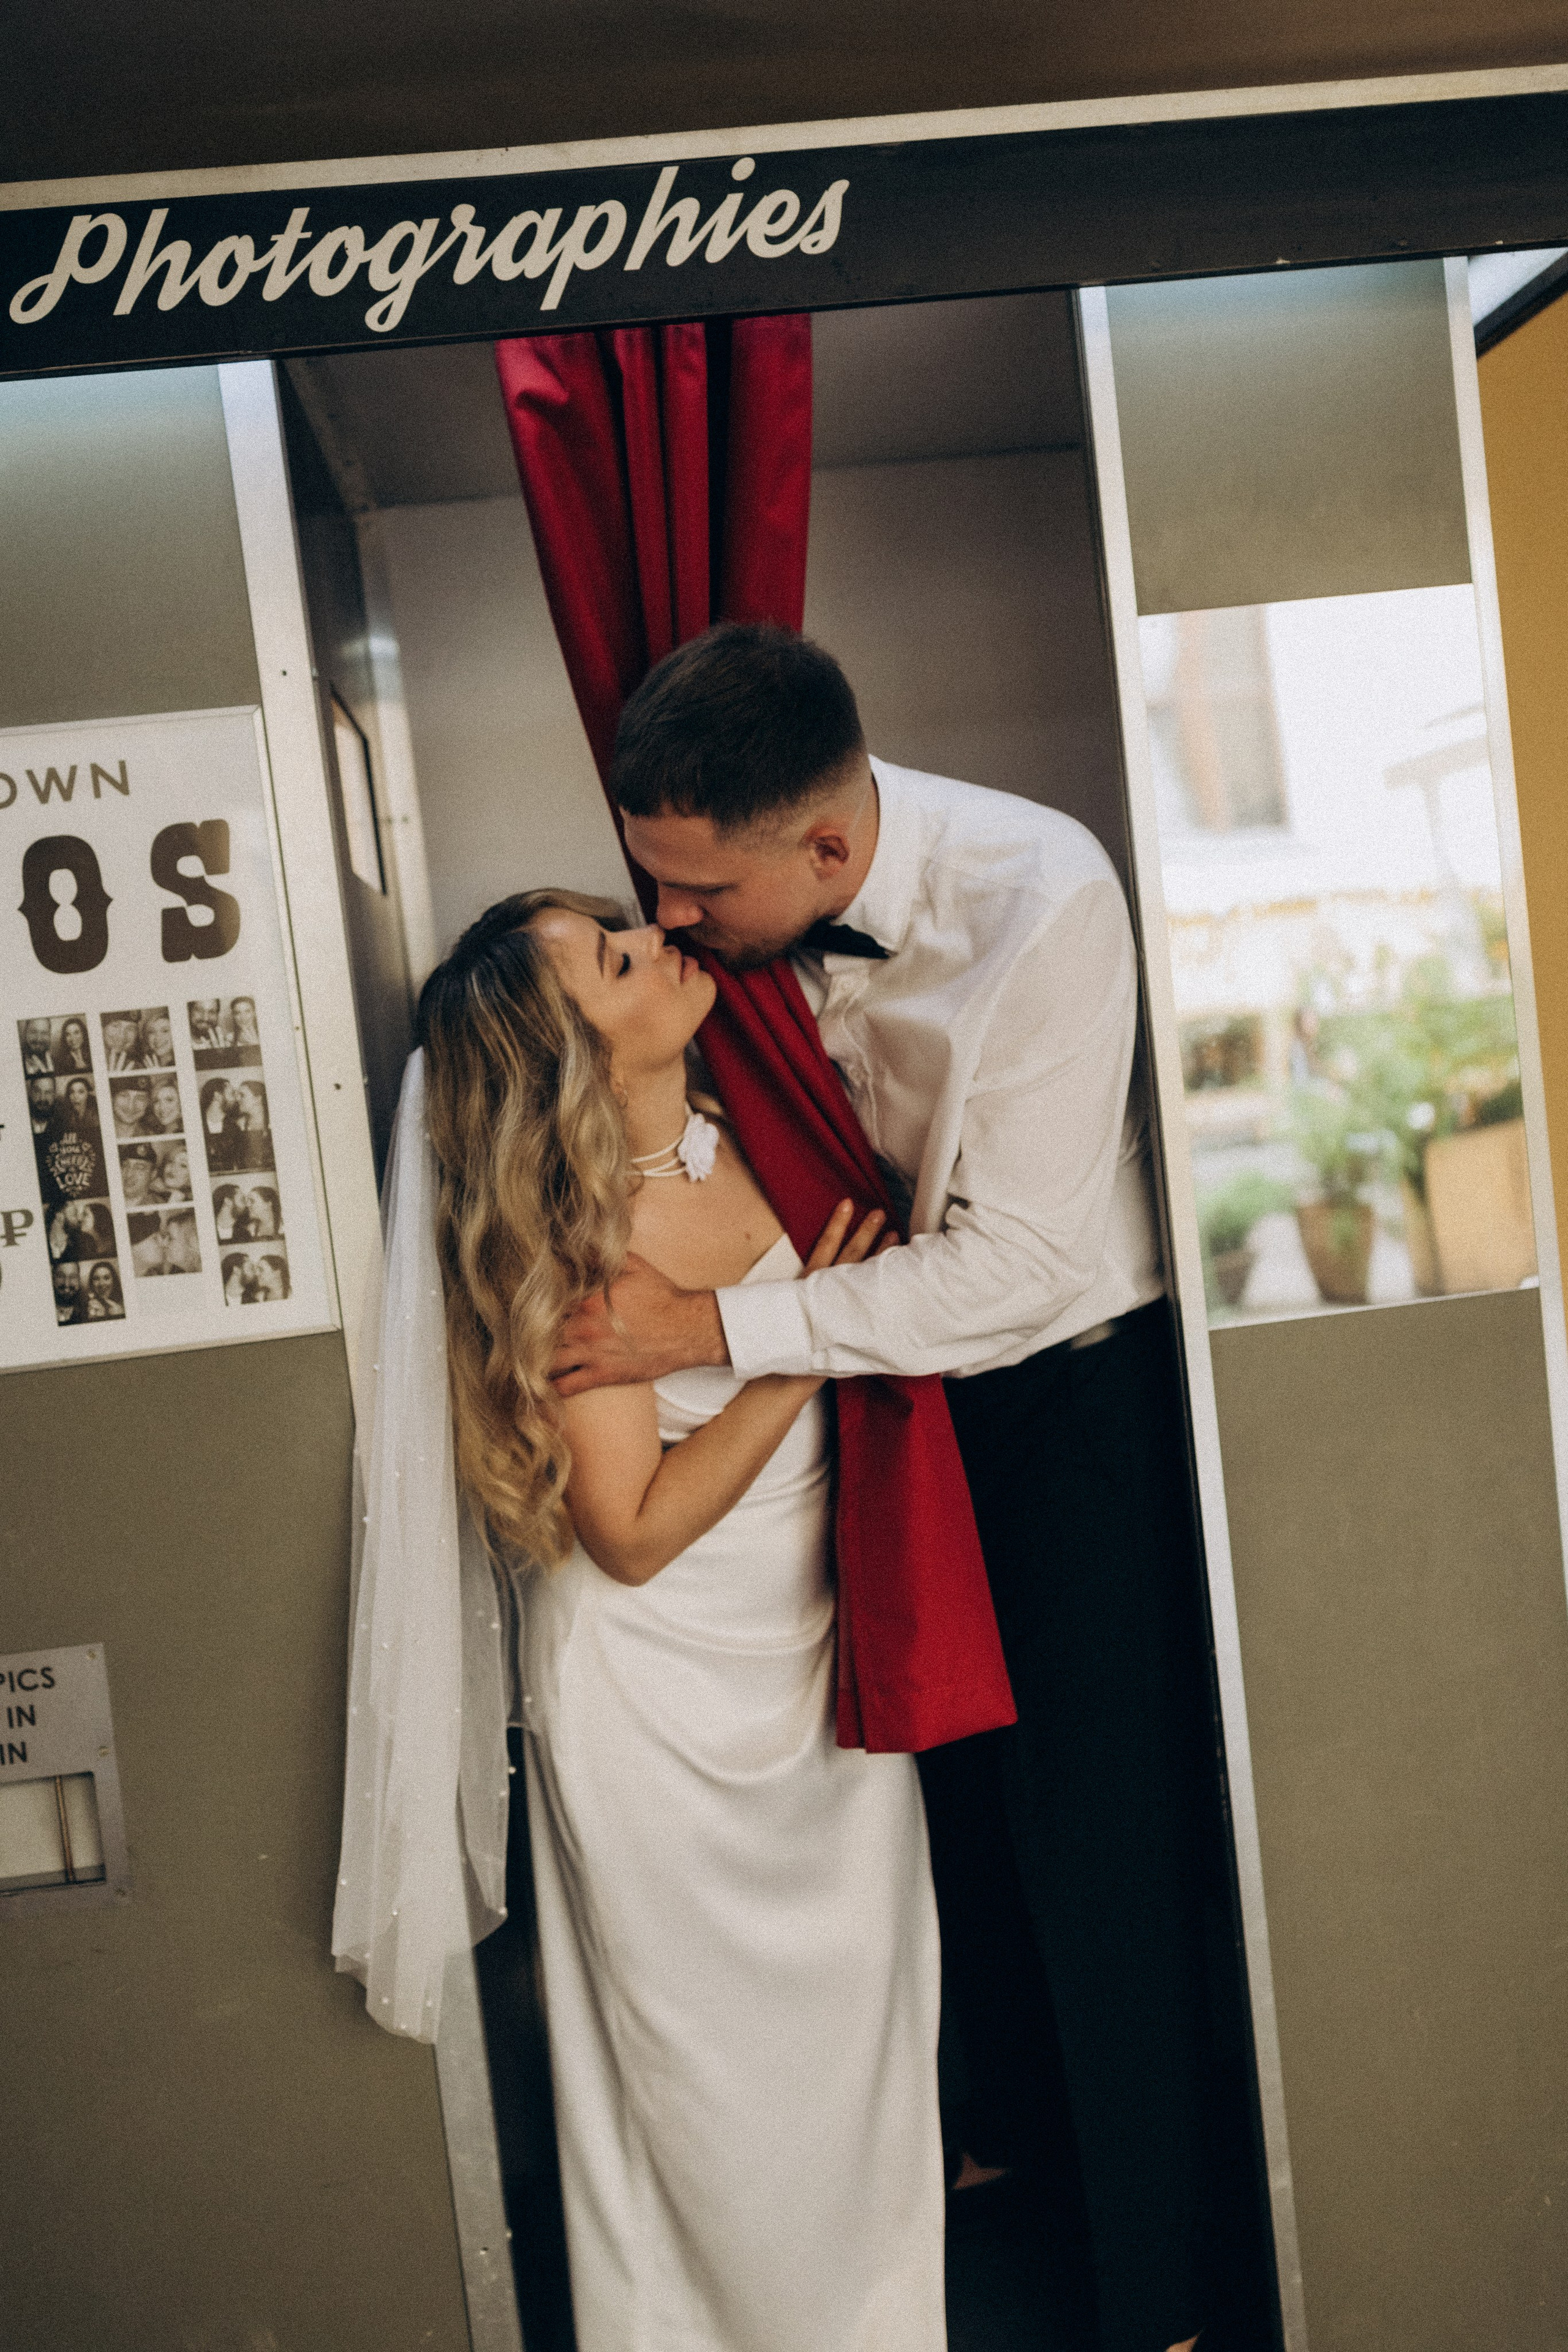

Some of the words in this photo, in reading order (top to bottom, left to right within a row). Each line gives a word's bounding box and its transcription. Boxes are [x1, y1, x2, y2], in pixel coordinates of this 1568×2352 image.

[9, 157, 850, 333] Photographies
[17, 818, 241, 974] OS
[56, 1172, 91, 1189] LOVE
[7, 1703, 36, 1729] IN
